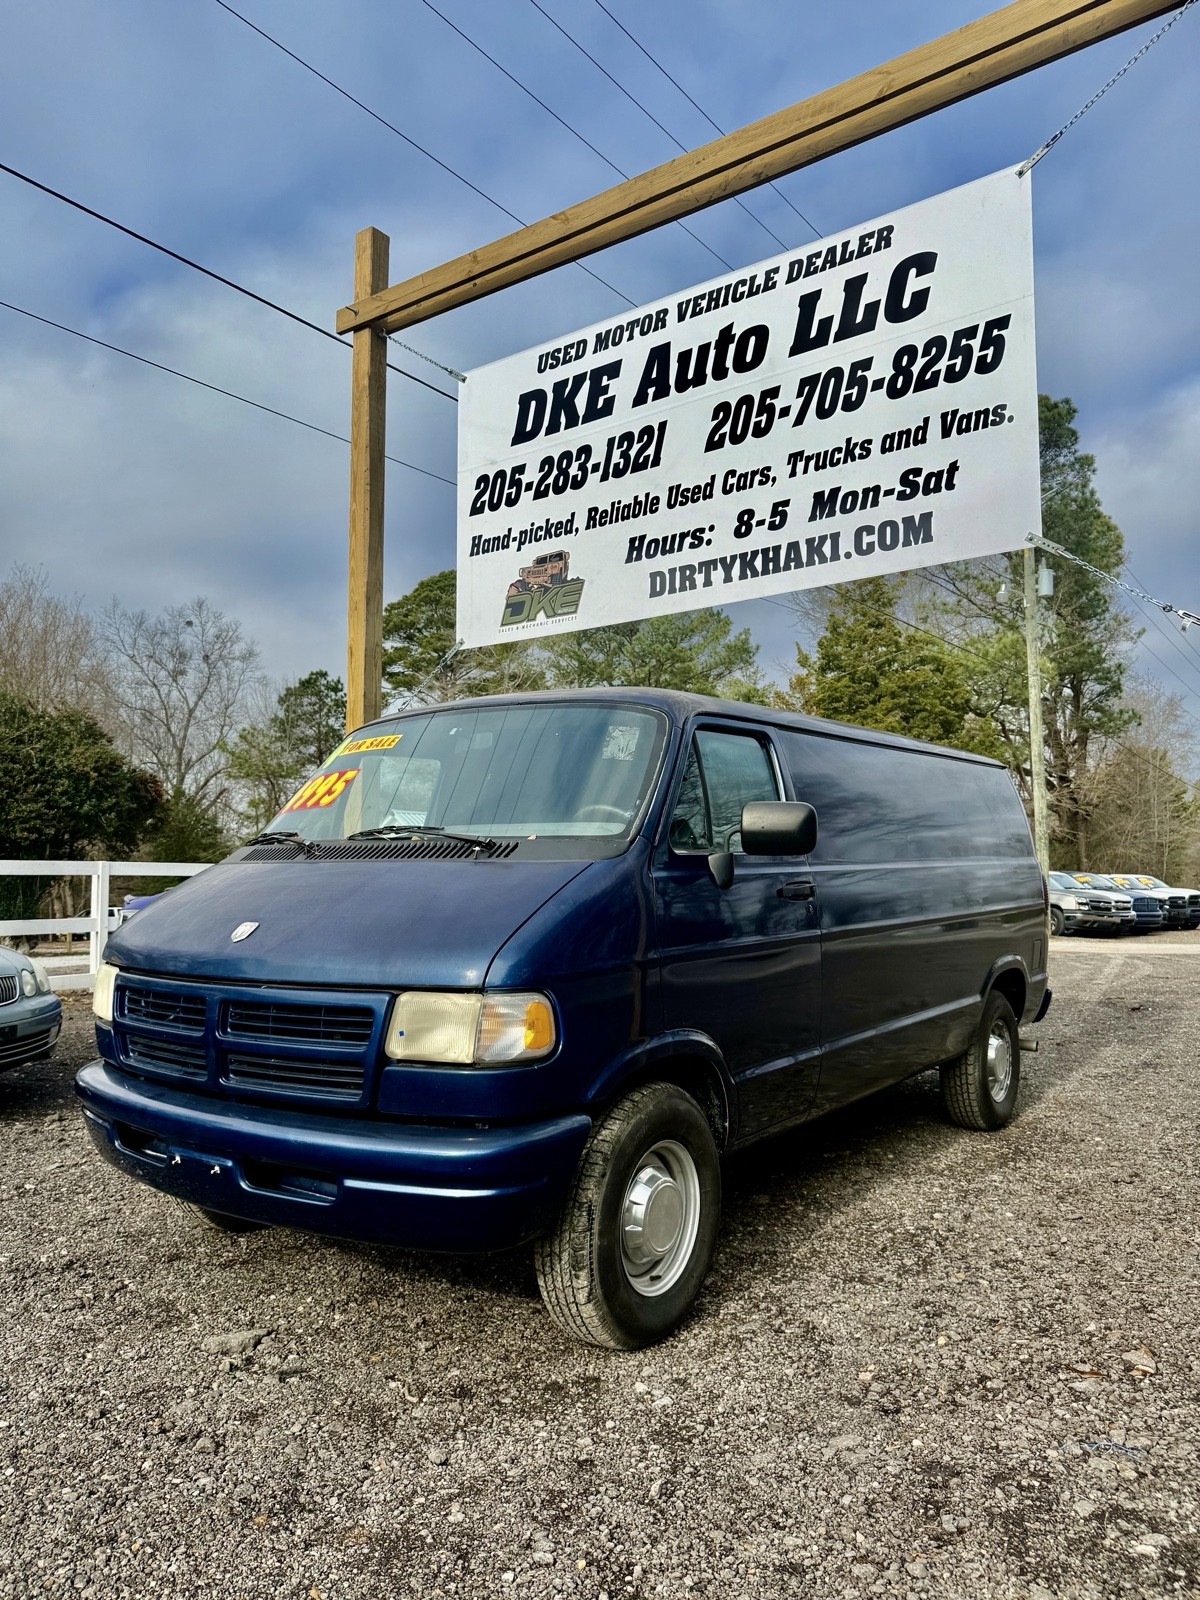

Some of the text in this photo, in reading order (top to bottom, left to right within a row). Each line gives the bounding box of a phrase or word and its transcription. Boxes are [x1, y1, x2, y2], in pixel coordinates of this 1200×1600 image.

[511, 251, 939, 447] DKE Auto LLC
[537, 225, 894, 375] USED MOTOR VEHICLE DEALER
[703, 314, 1012, 454] 205-705-8255
[469, 420, 669, 517] 205-283-1321
[469, 404, 1015, 558] Hand-picked, Reliable Used Cars, Trucks and Vans.
[625, 459, 961, 564] Hours: 8-5 Mon-Sat
[500, 579, 585, 627] DKE
[648, 511, 934, 599] DIRTYKHAKI.COM
[345, 736, 399, 753] FOR SALE
